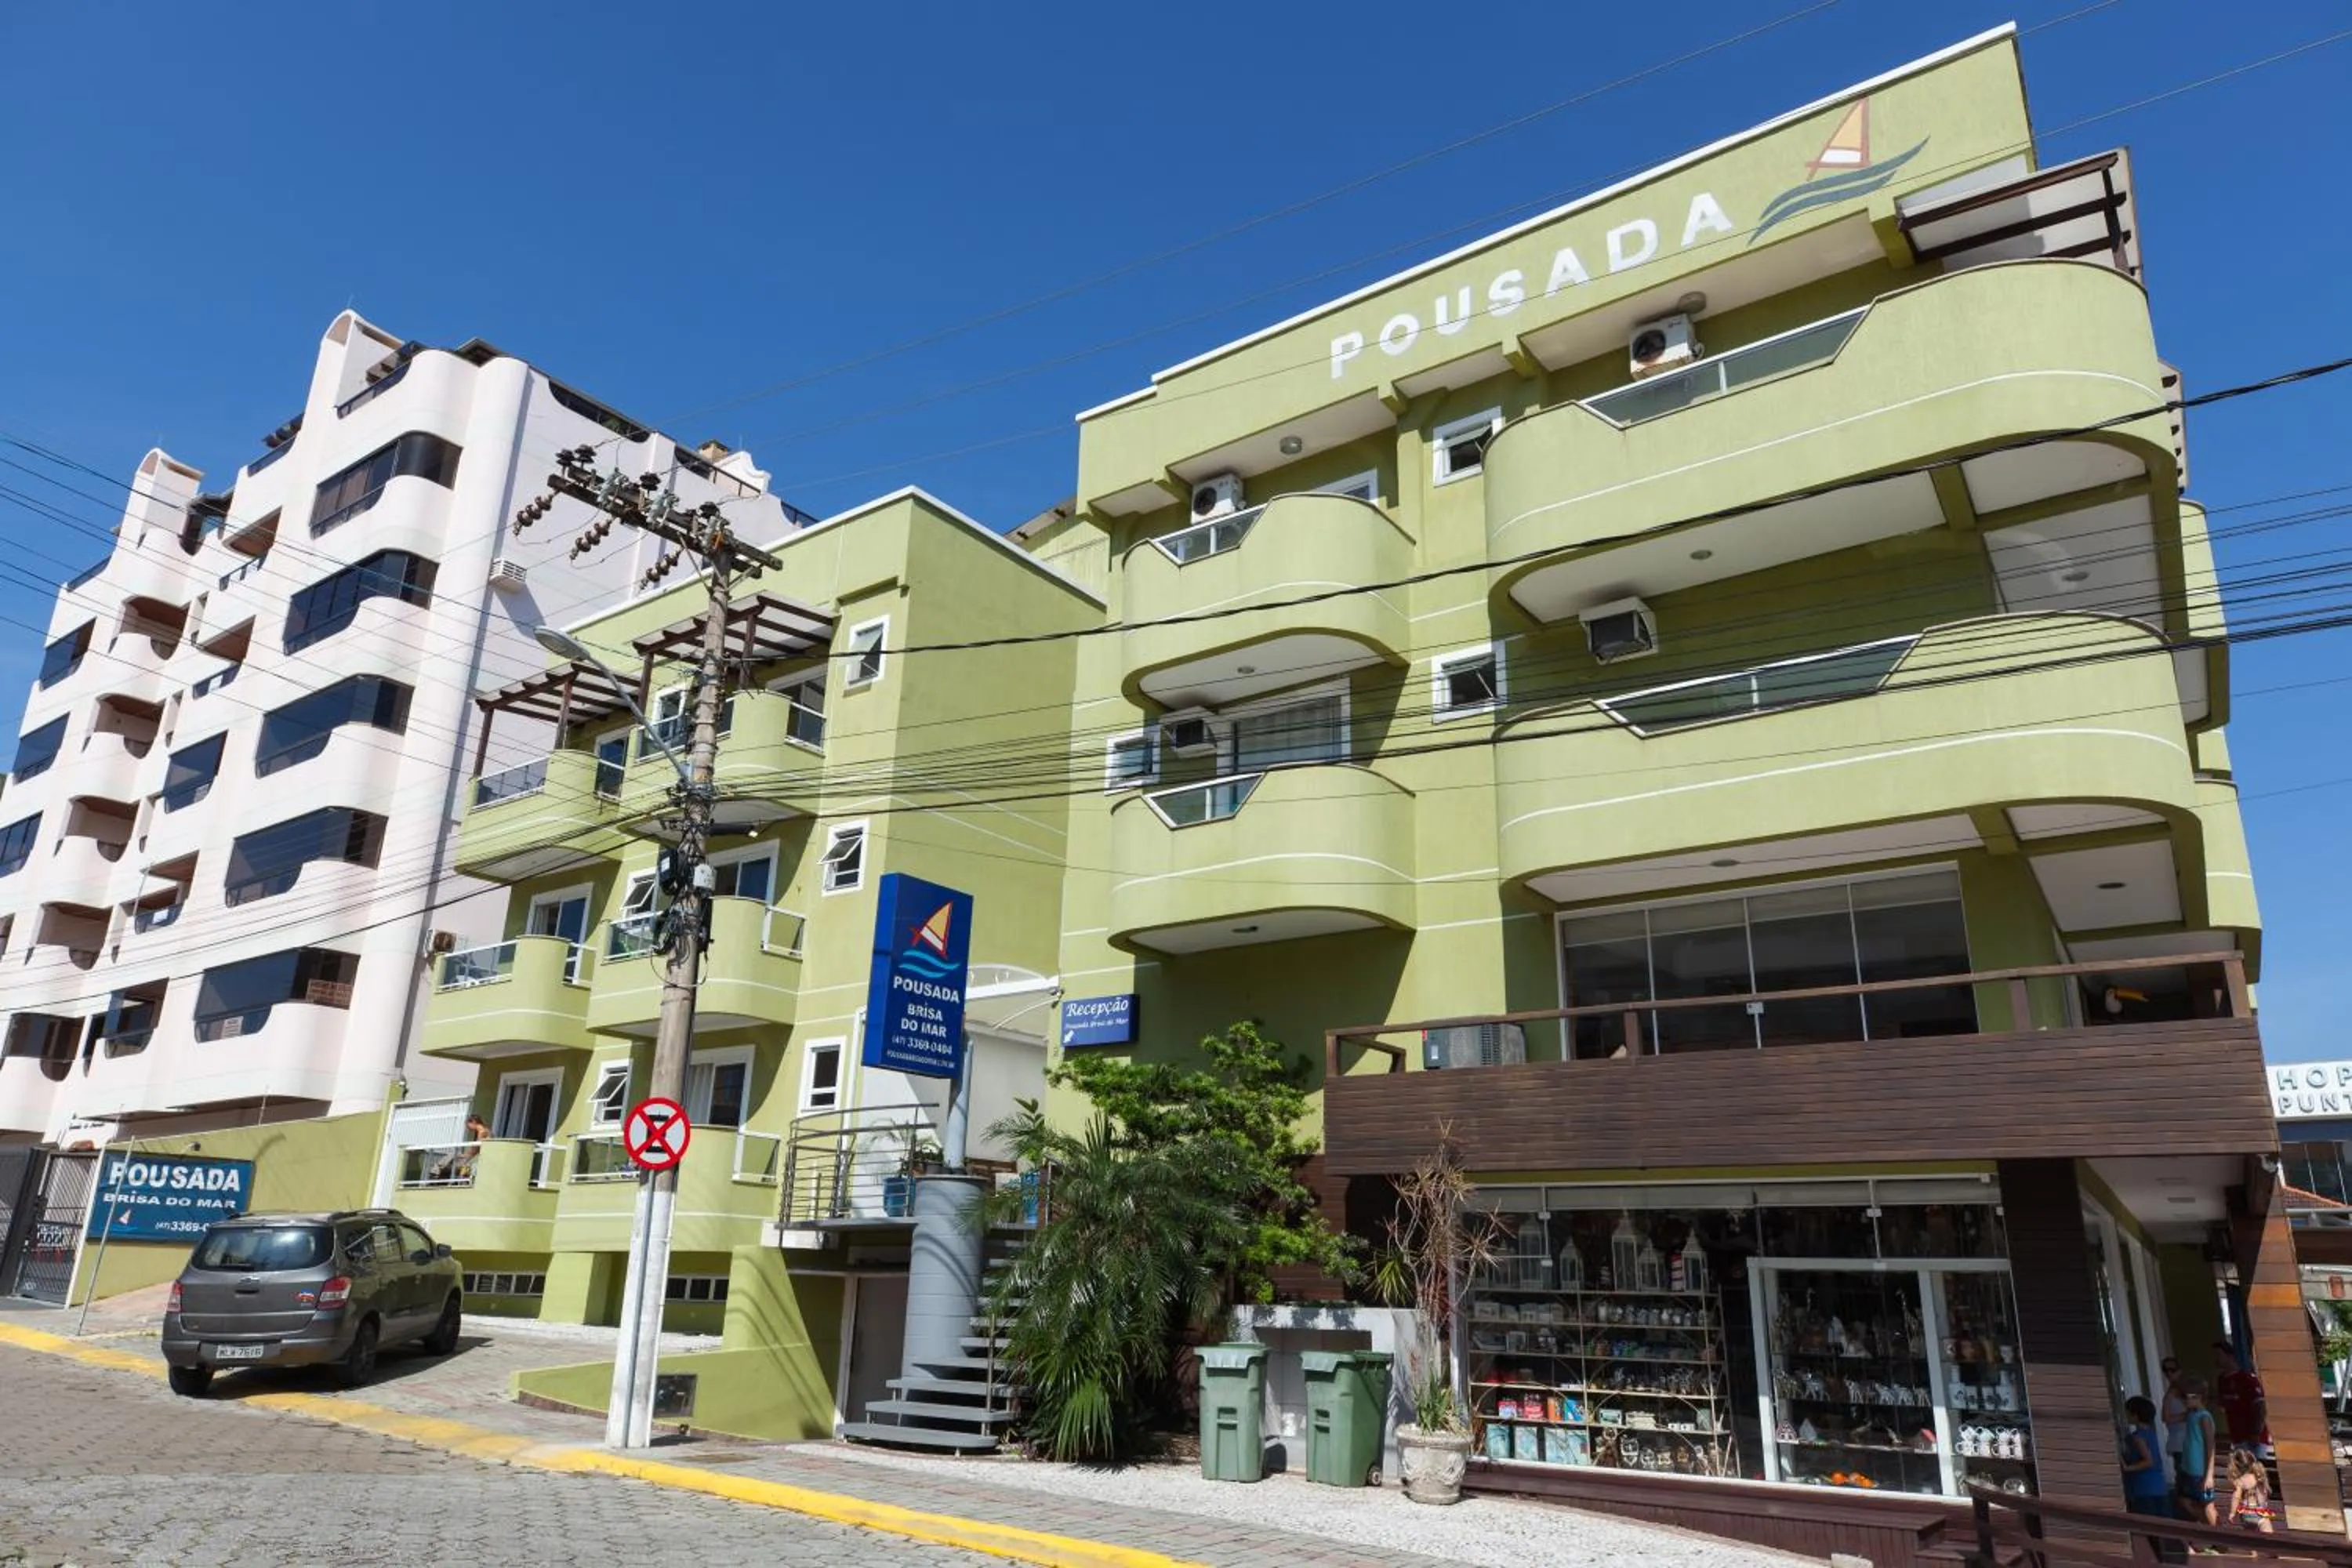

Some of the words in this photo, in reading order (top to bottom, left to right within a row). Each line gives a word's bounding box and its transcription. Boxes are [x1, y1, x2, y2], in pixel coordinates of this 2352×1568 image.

[1330, 192, 1735, 380] POUSADA
[893, 975, 960, 1004] POUSADA
[1066, 996, 1129, 1019] Recepção
[901, 1018, 918, 1032] DO
[921, 1022, 947, 1039] MAR
[108, 1161, 241, 1192] POUSADA
[165, 1197, 191, 1207] DO
[197, 1198, 237, 1209] MAR
